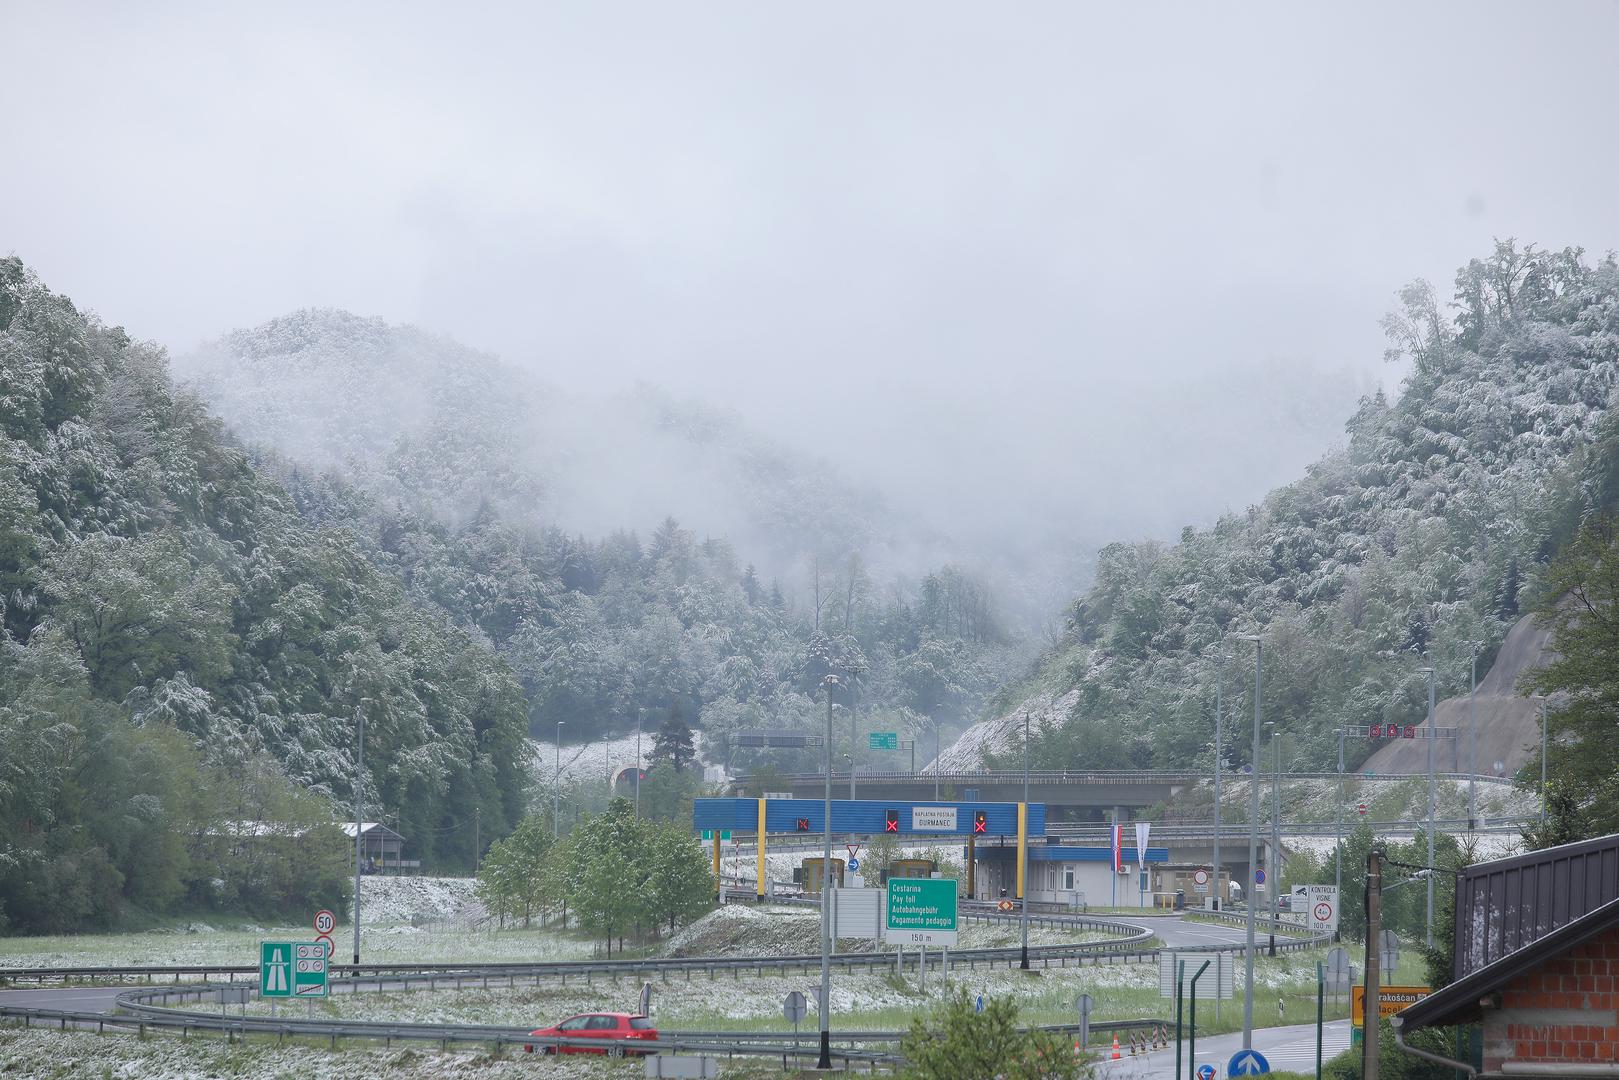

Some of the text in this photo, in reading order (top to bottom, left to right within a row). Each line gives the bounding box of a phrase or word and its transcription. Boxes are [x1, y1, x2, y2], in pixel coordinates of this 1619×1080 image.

[892, 884, 921, 892] Cestarina
[892, 894, 916, 904] Pay toll
[892, 905, 938, 915] Autobahngebühr
[318, 916, 331, 929] 50
[892, 916, 952, 926] Pagamento pedaggio
